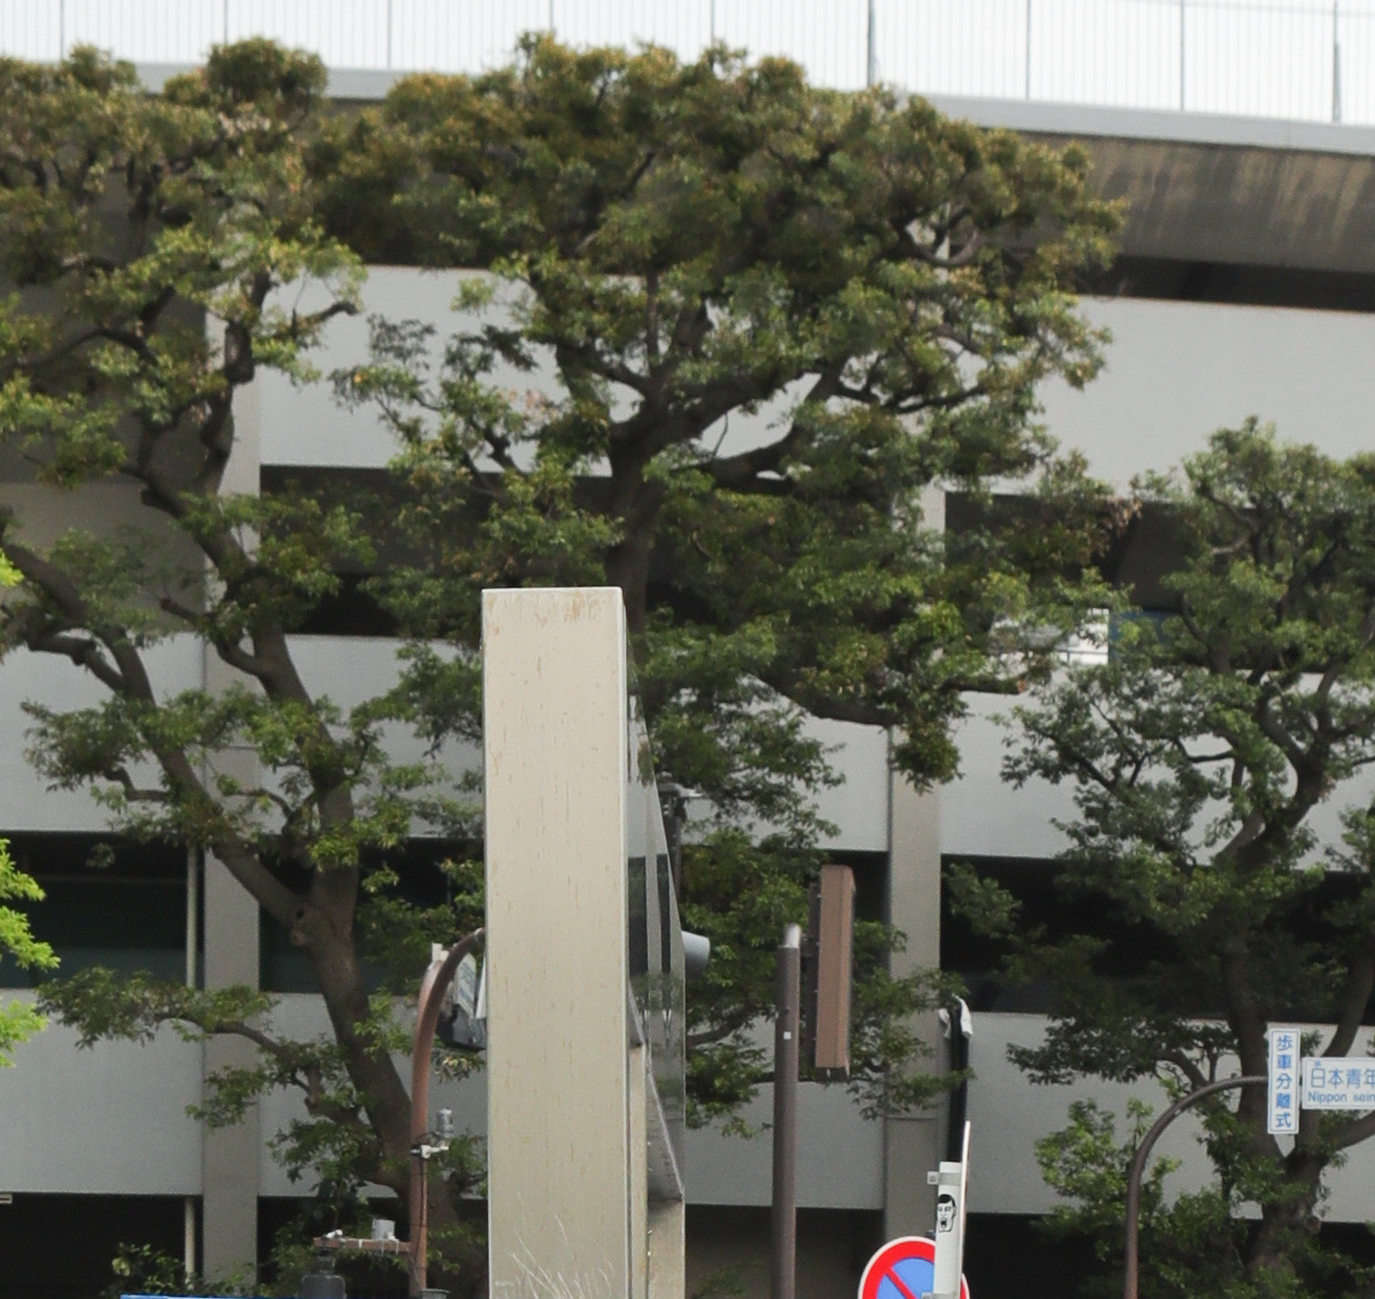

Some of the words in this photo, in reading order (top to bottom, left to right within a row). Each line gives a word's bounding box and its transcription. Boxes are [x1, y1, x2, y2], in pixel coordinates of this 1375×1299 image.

[1275, 1034, 1294, 1128] 歩車分離式
[1307, 1092, 1347, 1103] Nippon
